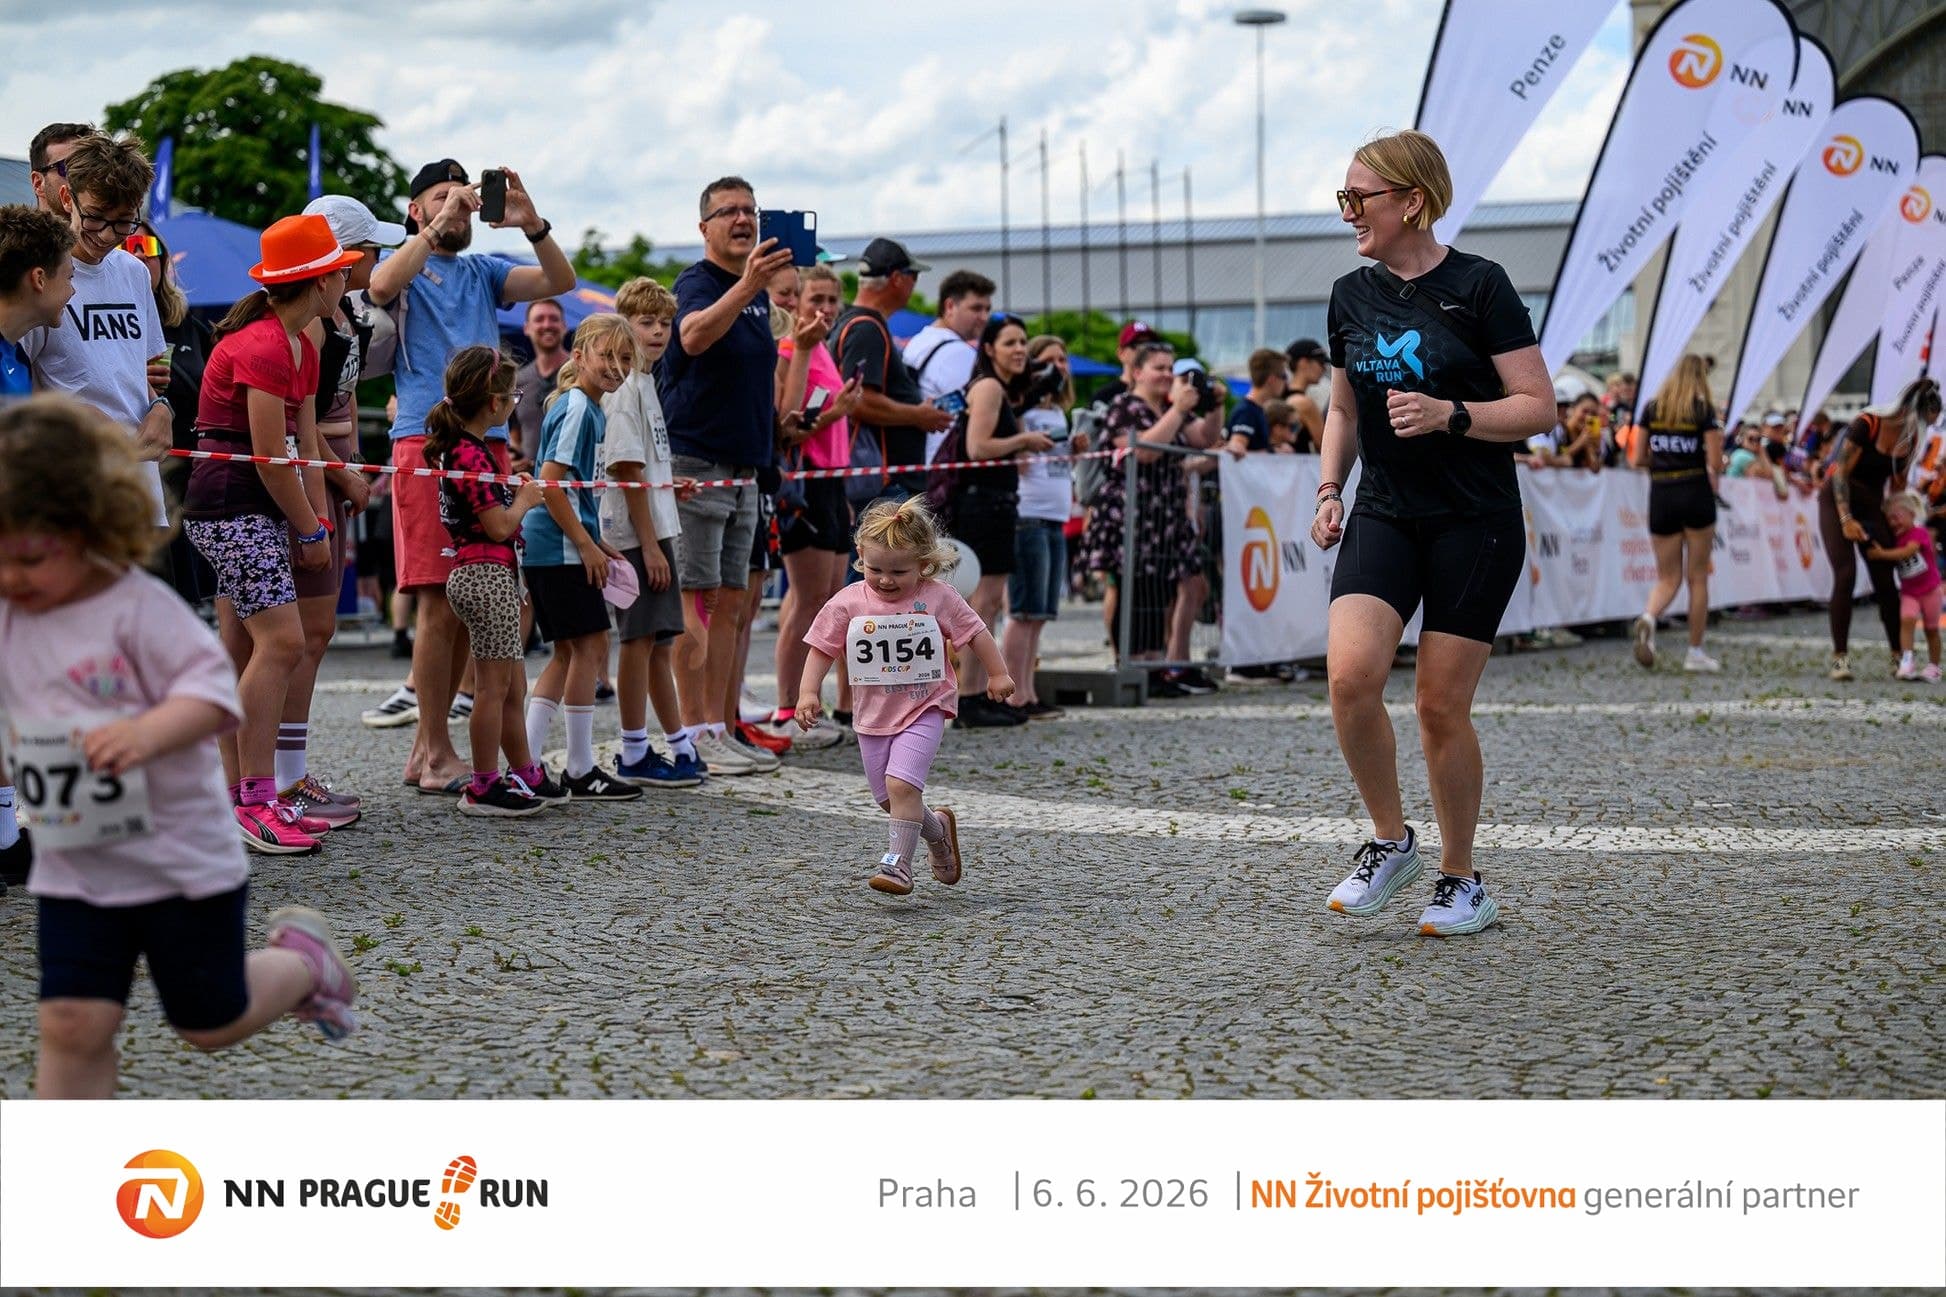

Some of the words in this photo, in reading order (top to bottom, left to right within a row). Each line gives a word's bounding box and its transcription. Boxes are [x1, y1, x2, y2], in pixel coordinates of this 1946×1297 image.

[1509, 33, 1567, 100] Penze
[1729, 64, 1769, 90] NN
[1781, 99, 1814, 118] NN
[1869, 155, 1899, 176] NN
[1598, 206, 1656, 273] Životní
[1652, 130, 1718, 216] pojištění
[1687, 232, 1733, 293] Životní
[1729, 160, 1778, 237] pojištění
[1933, 207, 1946, 224] N
[66, 303, 142, 341] VANS
[1355, 359, 1401, 373] VLTAVA
[1376, 370, 1403, 383] RUN
[1649, 434, 1698, 454] CREW
[1282, 540, 1307, 573] NN
[888, 622, 908, 630] PRAGUE
[855, 636, 935, 664] 3154
[881, 665, 897, 673] KIDS
[897, 665, 911, 673] CUP
[9, 755, 124, 809] 073
[1468, 886, 1486, 911] HOKA
